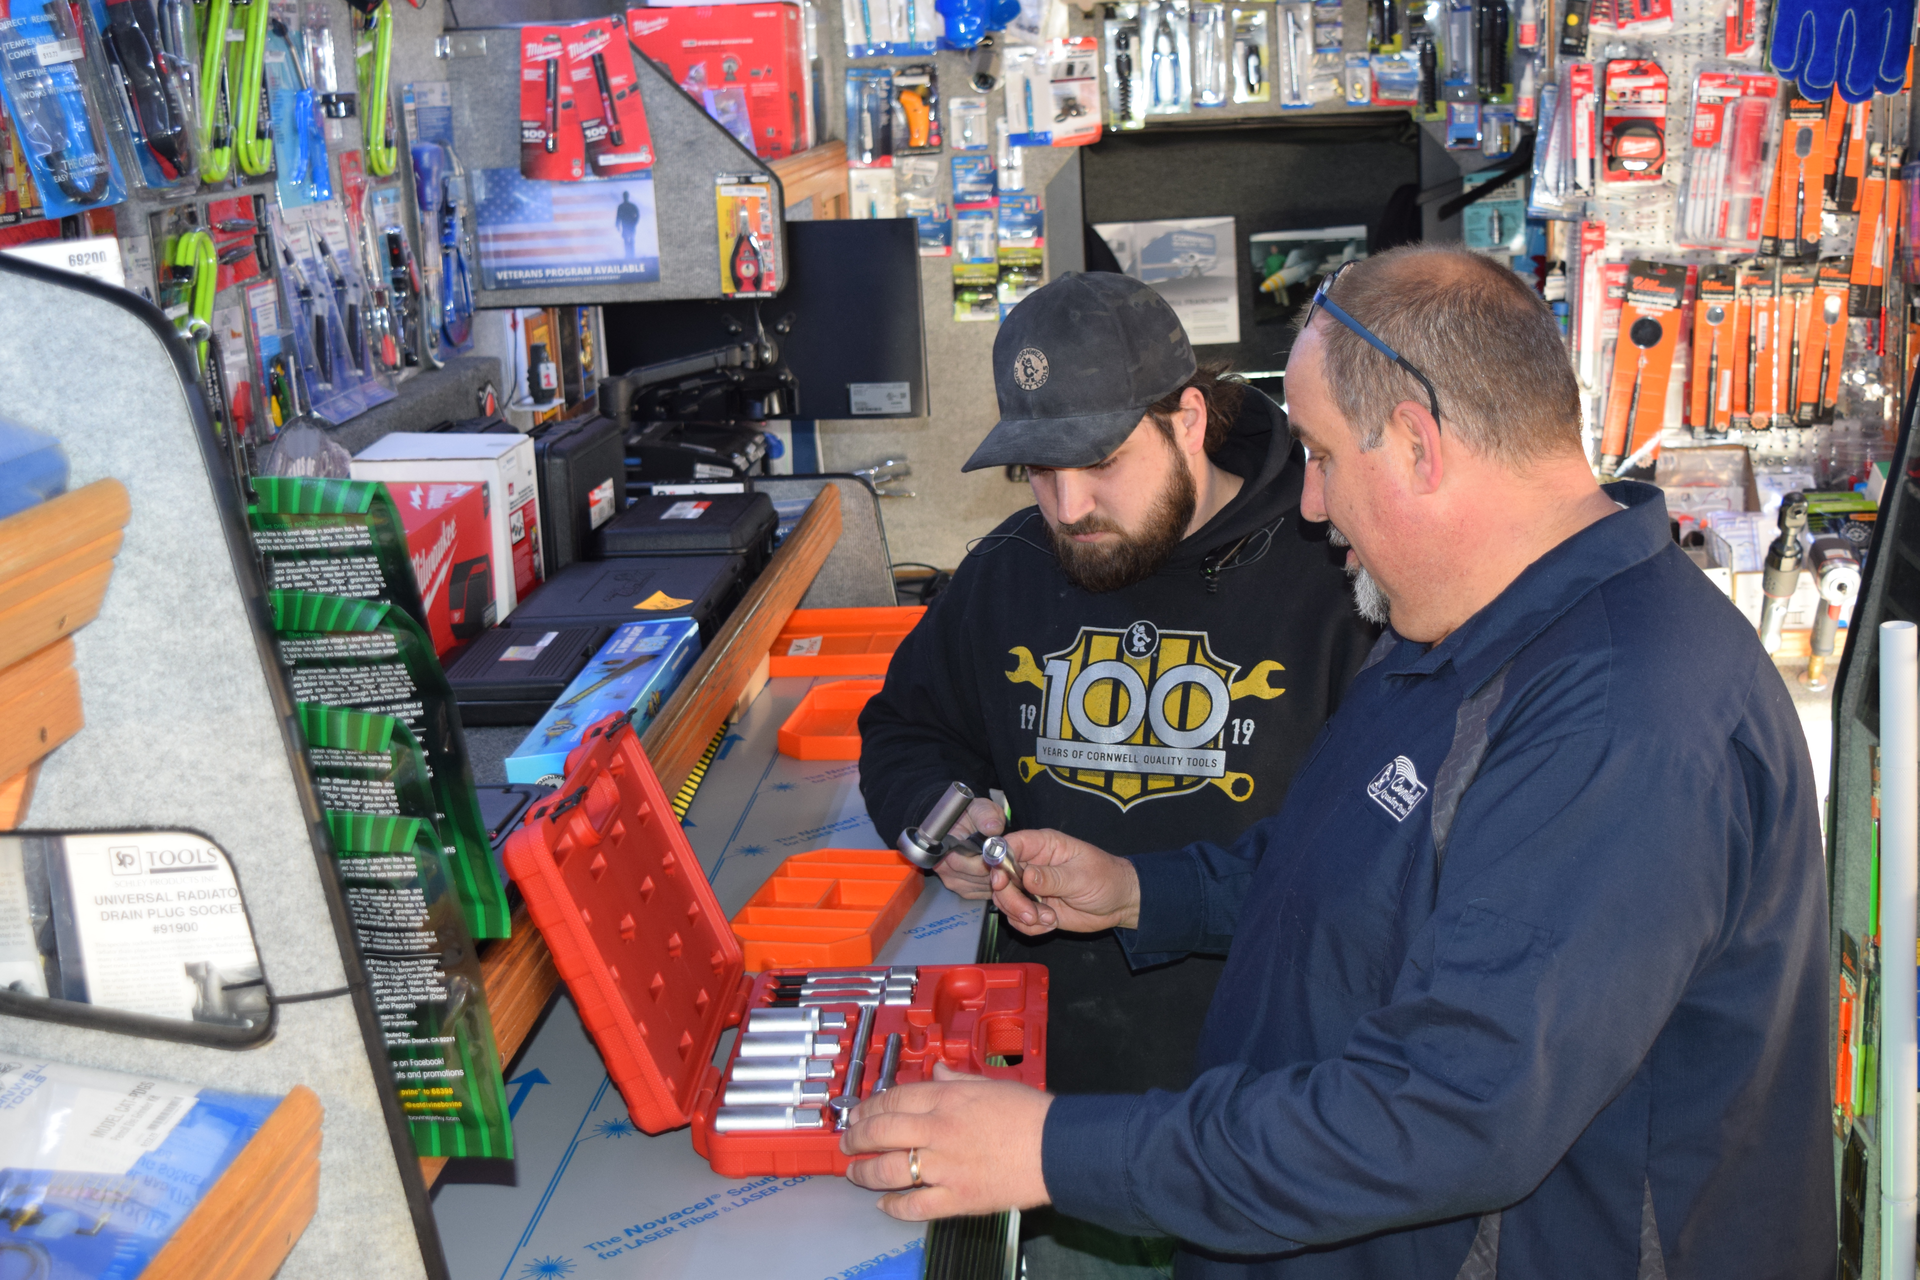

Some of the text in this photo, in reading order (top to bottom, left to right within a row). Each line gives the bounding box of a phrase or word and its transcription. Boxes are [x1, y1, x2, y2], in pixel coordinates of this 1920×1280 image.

[9, 49, 37, 60] COMPE
[523, 130, 546, 139] 100
[585, 126, 608, 138] 100
[68, 250, 108, 268] 69200
[496, 264, 646, 280] VETERANS PROGRAM AVAILABLE
[1016, 348, 1046, 364] CORNWELL
[543, 373, 555, 387] 1
[1013, 365, 1049, 390] QUALITY TOOLS
[1043, 659, 1230, 749] 100
[1019, 703, 1037, 730] 19
[1231, 719, 1255, 745] 19
[1042, 746, 1218, 769] YEARS OF CORNWELL QUALITY TOOLS
[1391, 777, 1421, 805] Cornwell
[1380, 790, 1400, 810] Quality
[145, 847, 219, 867] TOOLS
[114, 874, 221, 889] SCHLEY PRODUCTS INC.
[94, 887, 241, 906] UNIVERSAL RADIATO
[100, 909, 144, 922] DRAIN
[147, 906, 186, 919] PLUG
[153, 921, 199, 935] #91900
[408, 972, 432, 981] Cayenne
[383, 994, 407, 1003] Jalapeño
[429, 993, 447, 1001] (Diced
[391, 1002, 417, 1010] Peppers).
[410, 1057, 445, 1066] Facebook!
[408, 1069, 464, 1079] and promotions
[3, 1075, 48, 1110] TOOLS
[431, 1087, 454, 1095] 68398
[90, 1113, 125, 1139] MODEL
[583, 1235, 623, 1252] The
[726, 1175, 780, 1197] Soluti
[597, 1246, 624, 1260] for
[623, 1226, 681, 1250] LASER
[678, 1208, 720, 1229] Fiber
[730, 1185, 783, 1209] LASER
